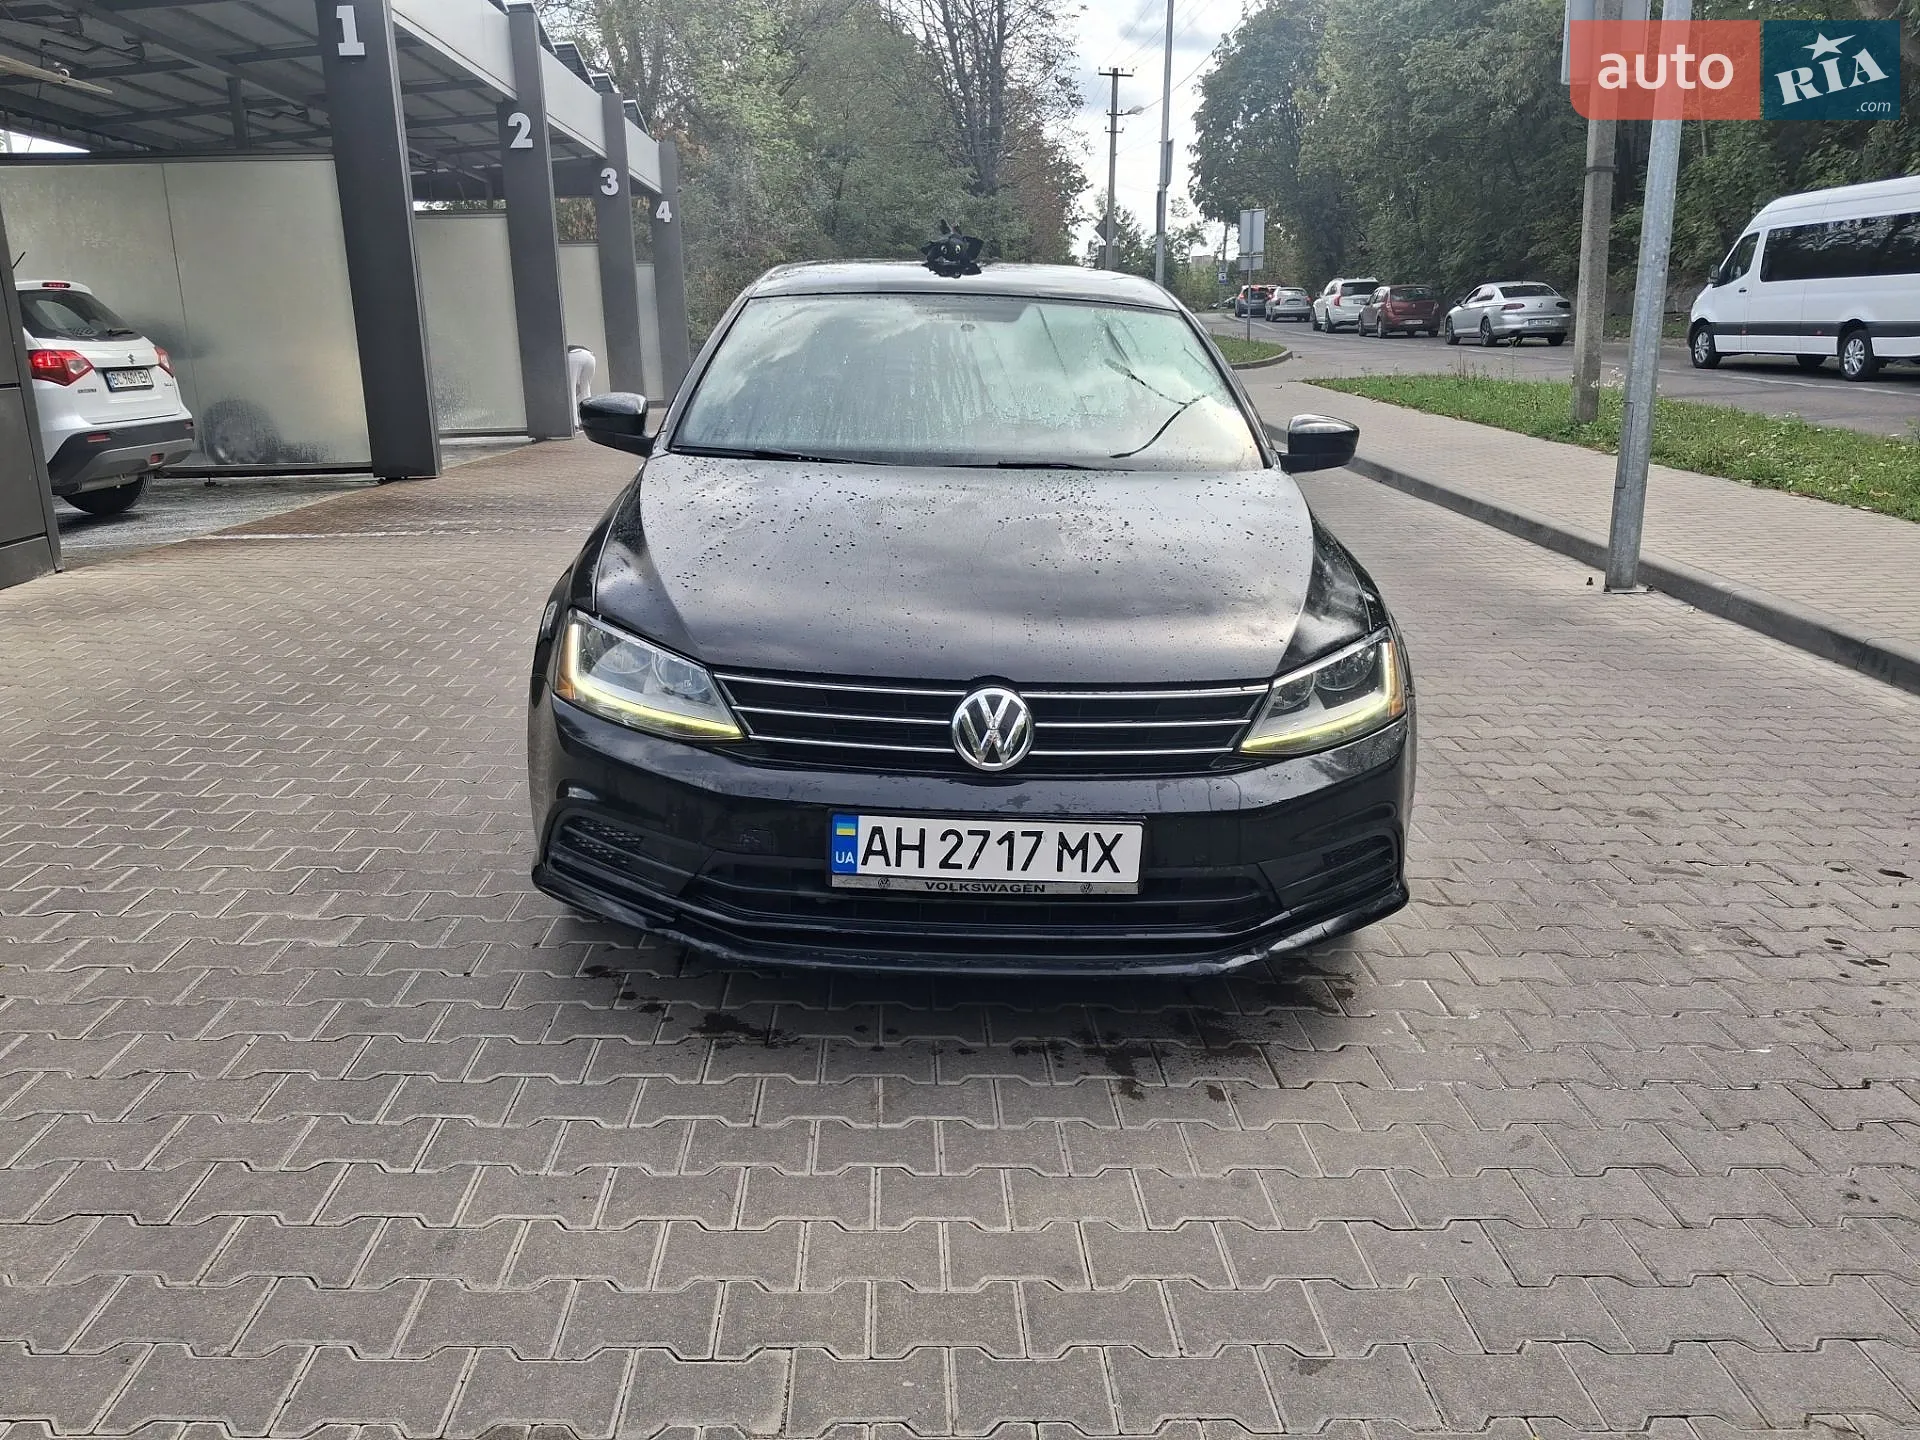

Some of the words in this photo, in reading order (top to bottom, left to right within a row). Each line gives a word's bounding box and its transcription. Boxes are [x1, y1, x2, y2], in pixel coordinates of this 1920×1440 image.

[336, 5, 365, 55] 1
[508, 113, 532, 148] 2
[600, 168, 618, 195] 3
[656, 201, 672, 222] 4
[835, 853, 855, 864] UA
[861, 826, 926, 868] AH
[939, 829, 1044, 871] 2717
[1057, 832, 1123, 873] MX
[924, 881, 1045, 893] VOLKSWAGEN
